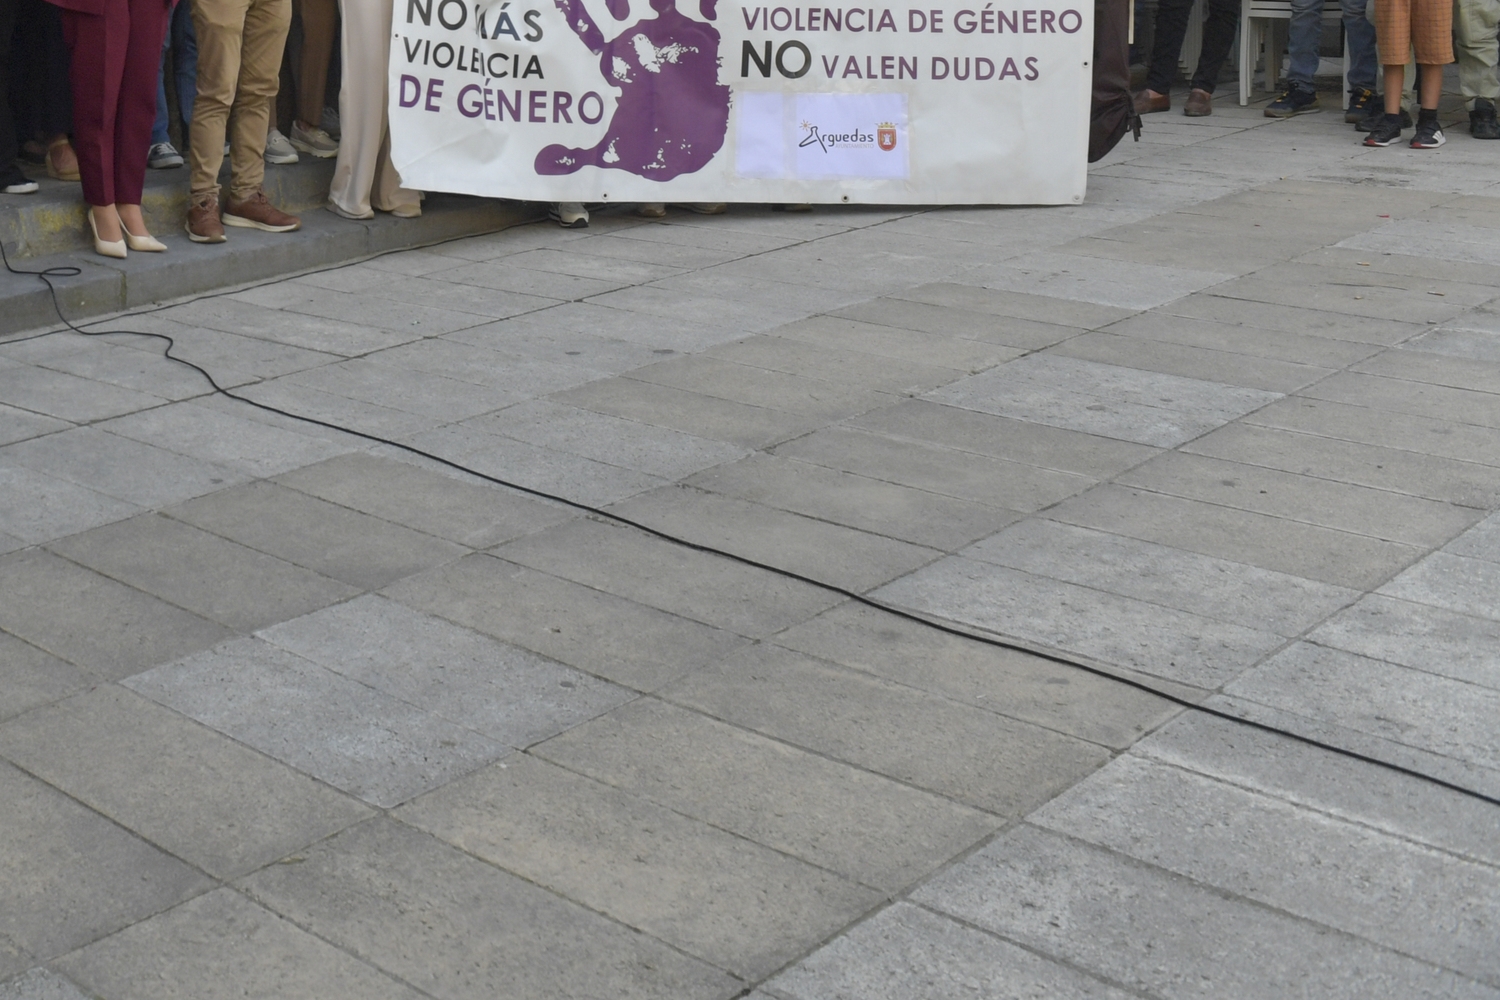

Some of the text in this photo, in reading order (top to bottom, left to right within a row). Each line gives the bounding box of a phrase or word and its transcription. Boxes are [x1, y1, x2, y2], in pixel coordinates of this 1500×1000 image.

[741, 2, 1083, 34] VIOLENCIA DE GÉNERO
[740, 40, 1040, 81] NO VALEN DUDAS
[399, 74, 604, 125] DE GÉNERO
